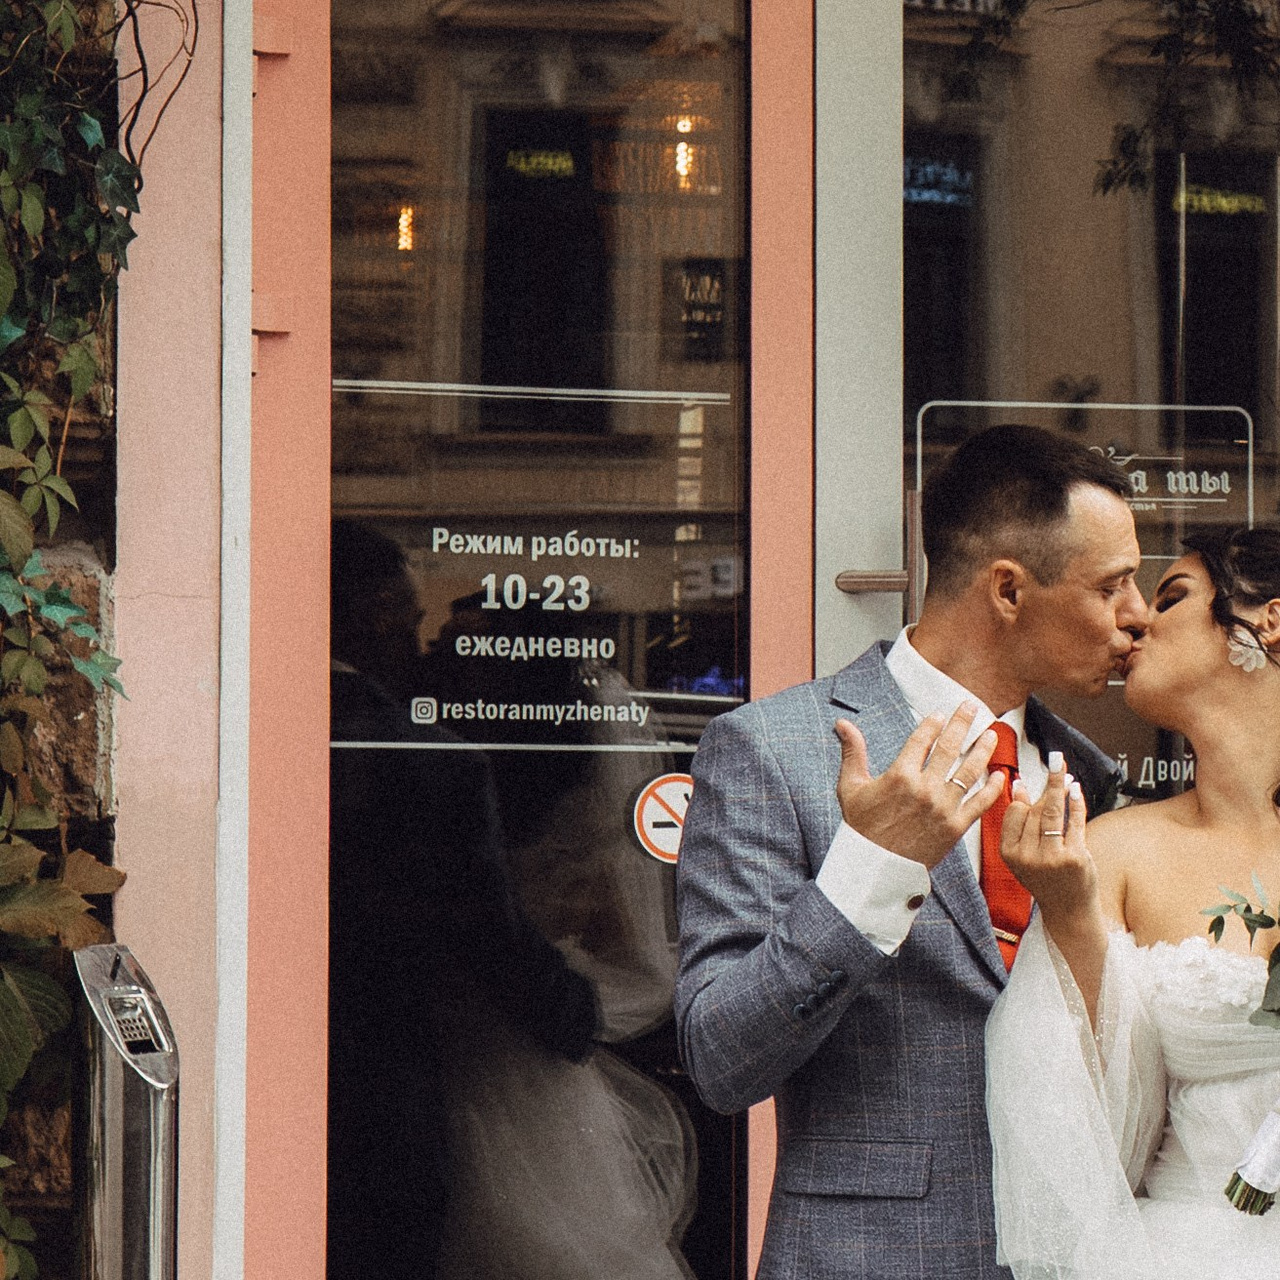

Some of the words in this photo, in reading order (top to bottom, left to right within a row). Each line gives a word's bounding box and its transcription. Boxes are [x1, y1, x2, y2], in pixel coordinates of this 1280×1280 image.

[1128, 470, 1150, 494] а
[432, 527, 524, 556] Режим
[531, 530, 640, 560] работы:
[480, 573, 591, 611] 10-23
[455, 634, 616, 660] ежедневно
[441, 697, 650, 726] restoranmyzhenaty
[1138, 753, 1195, 789] Двой
